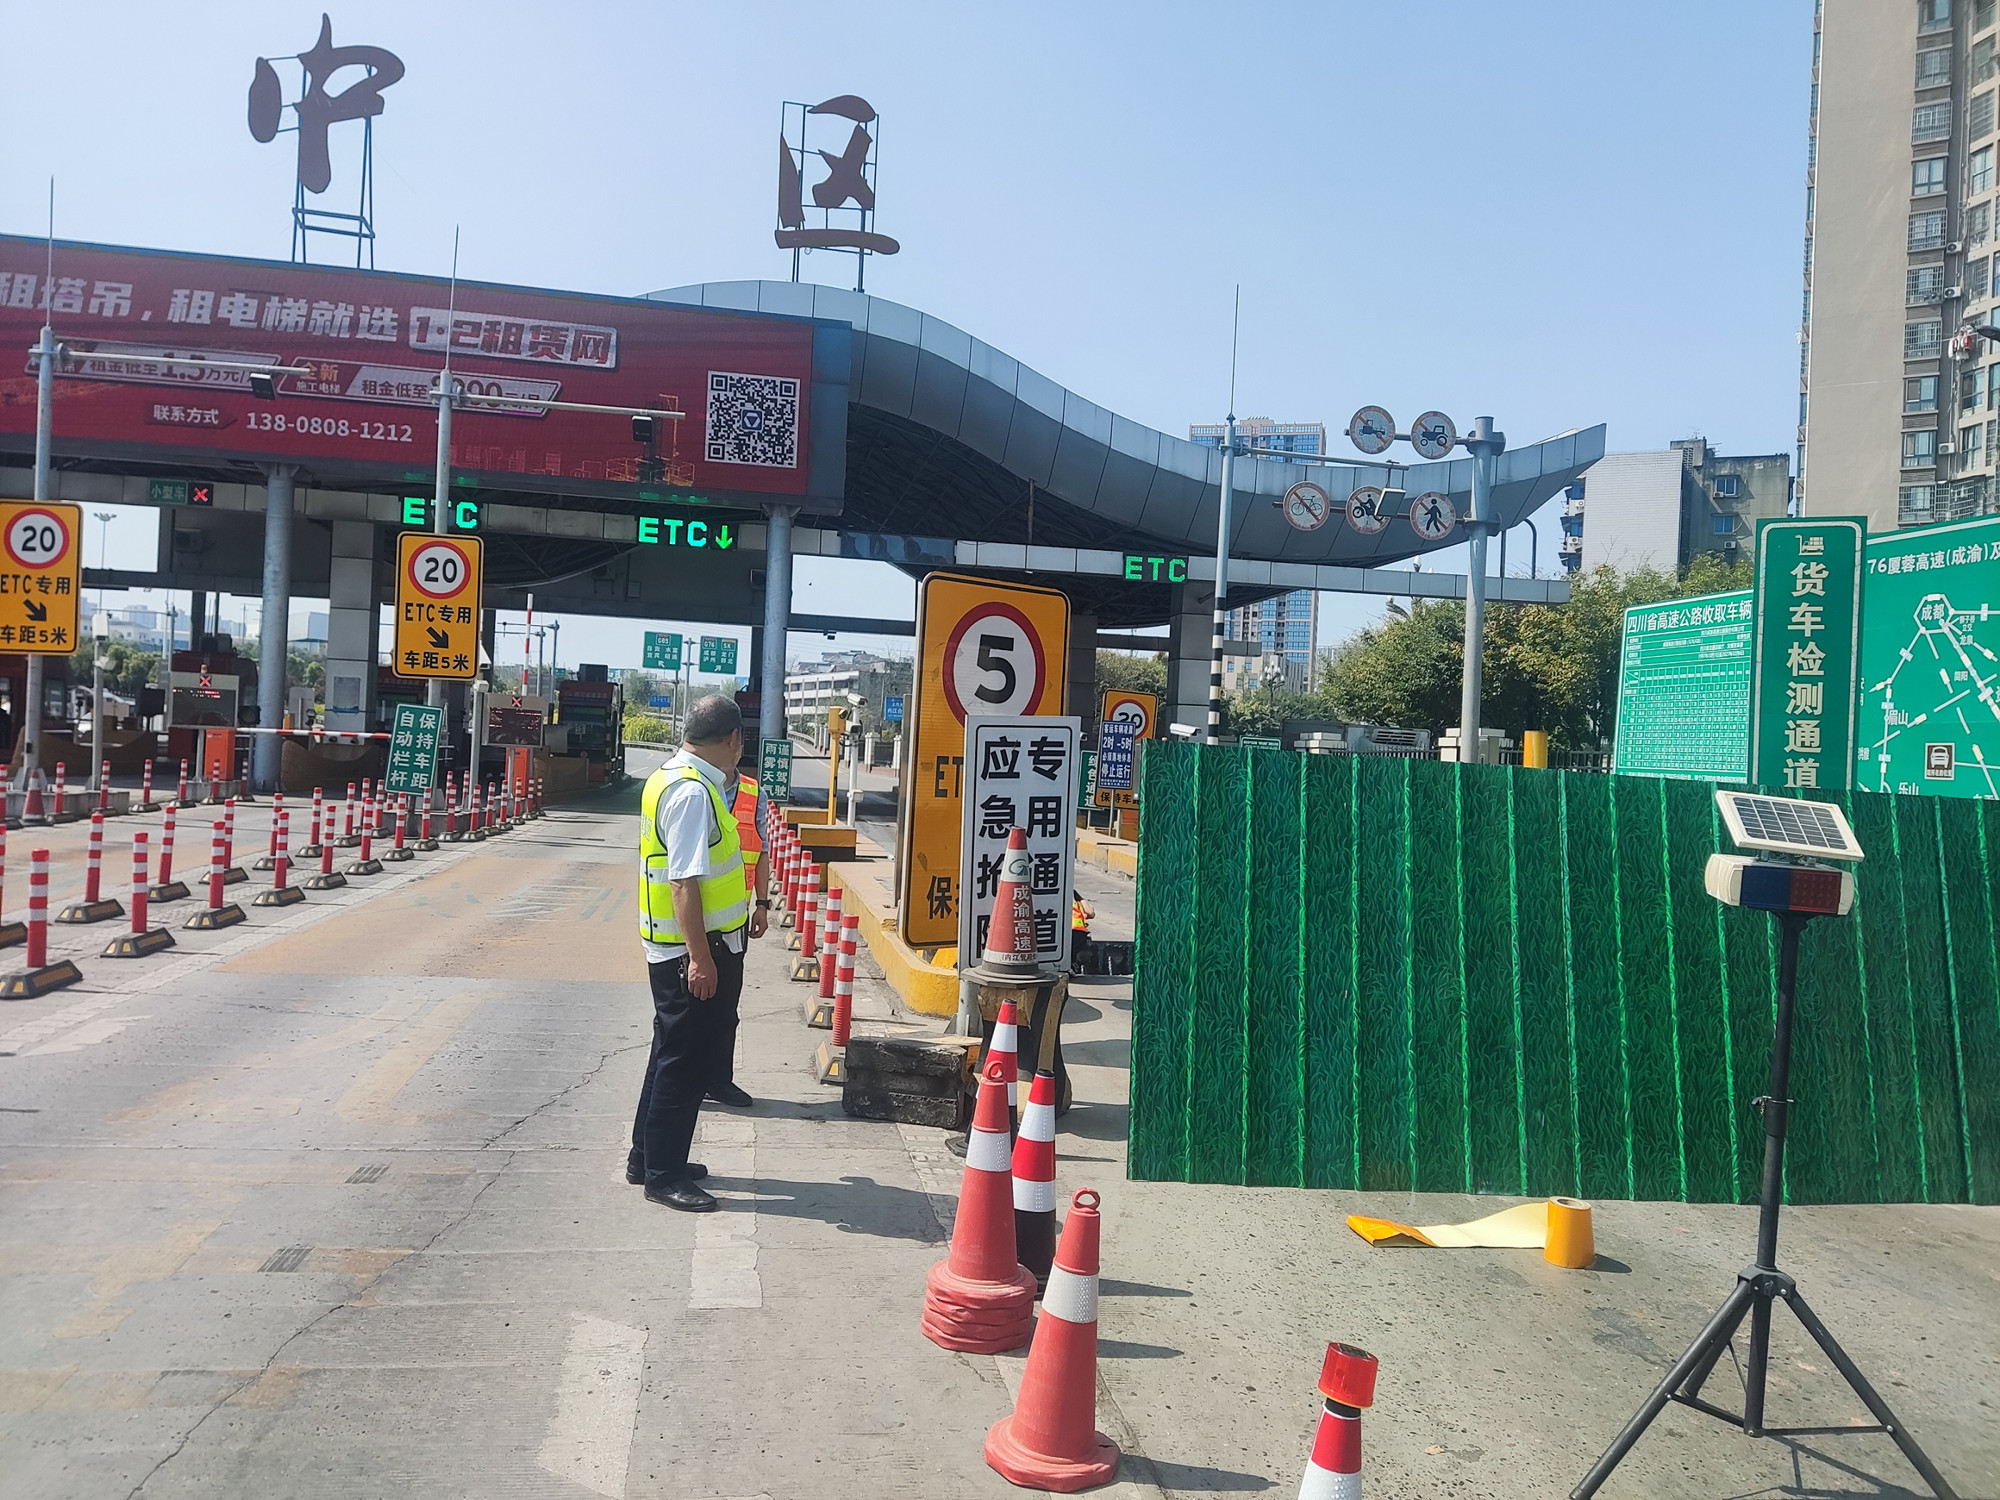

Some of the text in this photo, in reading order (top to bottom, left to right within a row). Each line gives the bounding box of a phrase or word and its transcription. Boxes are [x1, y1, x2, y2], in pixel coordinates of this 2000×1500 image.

[296, 381, 341, 394] 施工电梯
[153, 404, 219, 425] 联系方式
[246, 411, 413, 442] 138-0808-1212
[151, 484, 185, 500] 小型车
[403, 496, 478, 529] EC
[22, 525, 56, 552] 20
[638, 516, 708, 547] ETC
[424, 557, 458, 583] 20
[1125, 555, 1187, 583] ETC
[0, 574, 71, 595] ETC专用
[404, 602, 472, 624] ETC专用
[1627, 599, 1753, 634] 四川省高速公路收取车辆
[1921, 604, 1945, 621] 成都
[0, 624, 67, 645] 车距5米
[403, 650, 470, 672] 车距5米
[974, 633, 1017, 705] 5
[1783, 561, 1830, 789] 货车检测通道
[390, 711, 415, 787] 自动栏杆
[410, 712, 436, 789] 保持车距
[762, 743, 778, 796] 雨雾天气
[774, 743, 790, 797] 谨慎驾驶
[1101, 762, 1131, 779] 停止运行
[1012, 885, 1032, 952] 成渝高速
